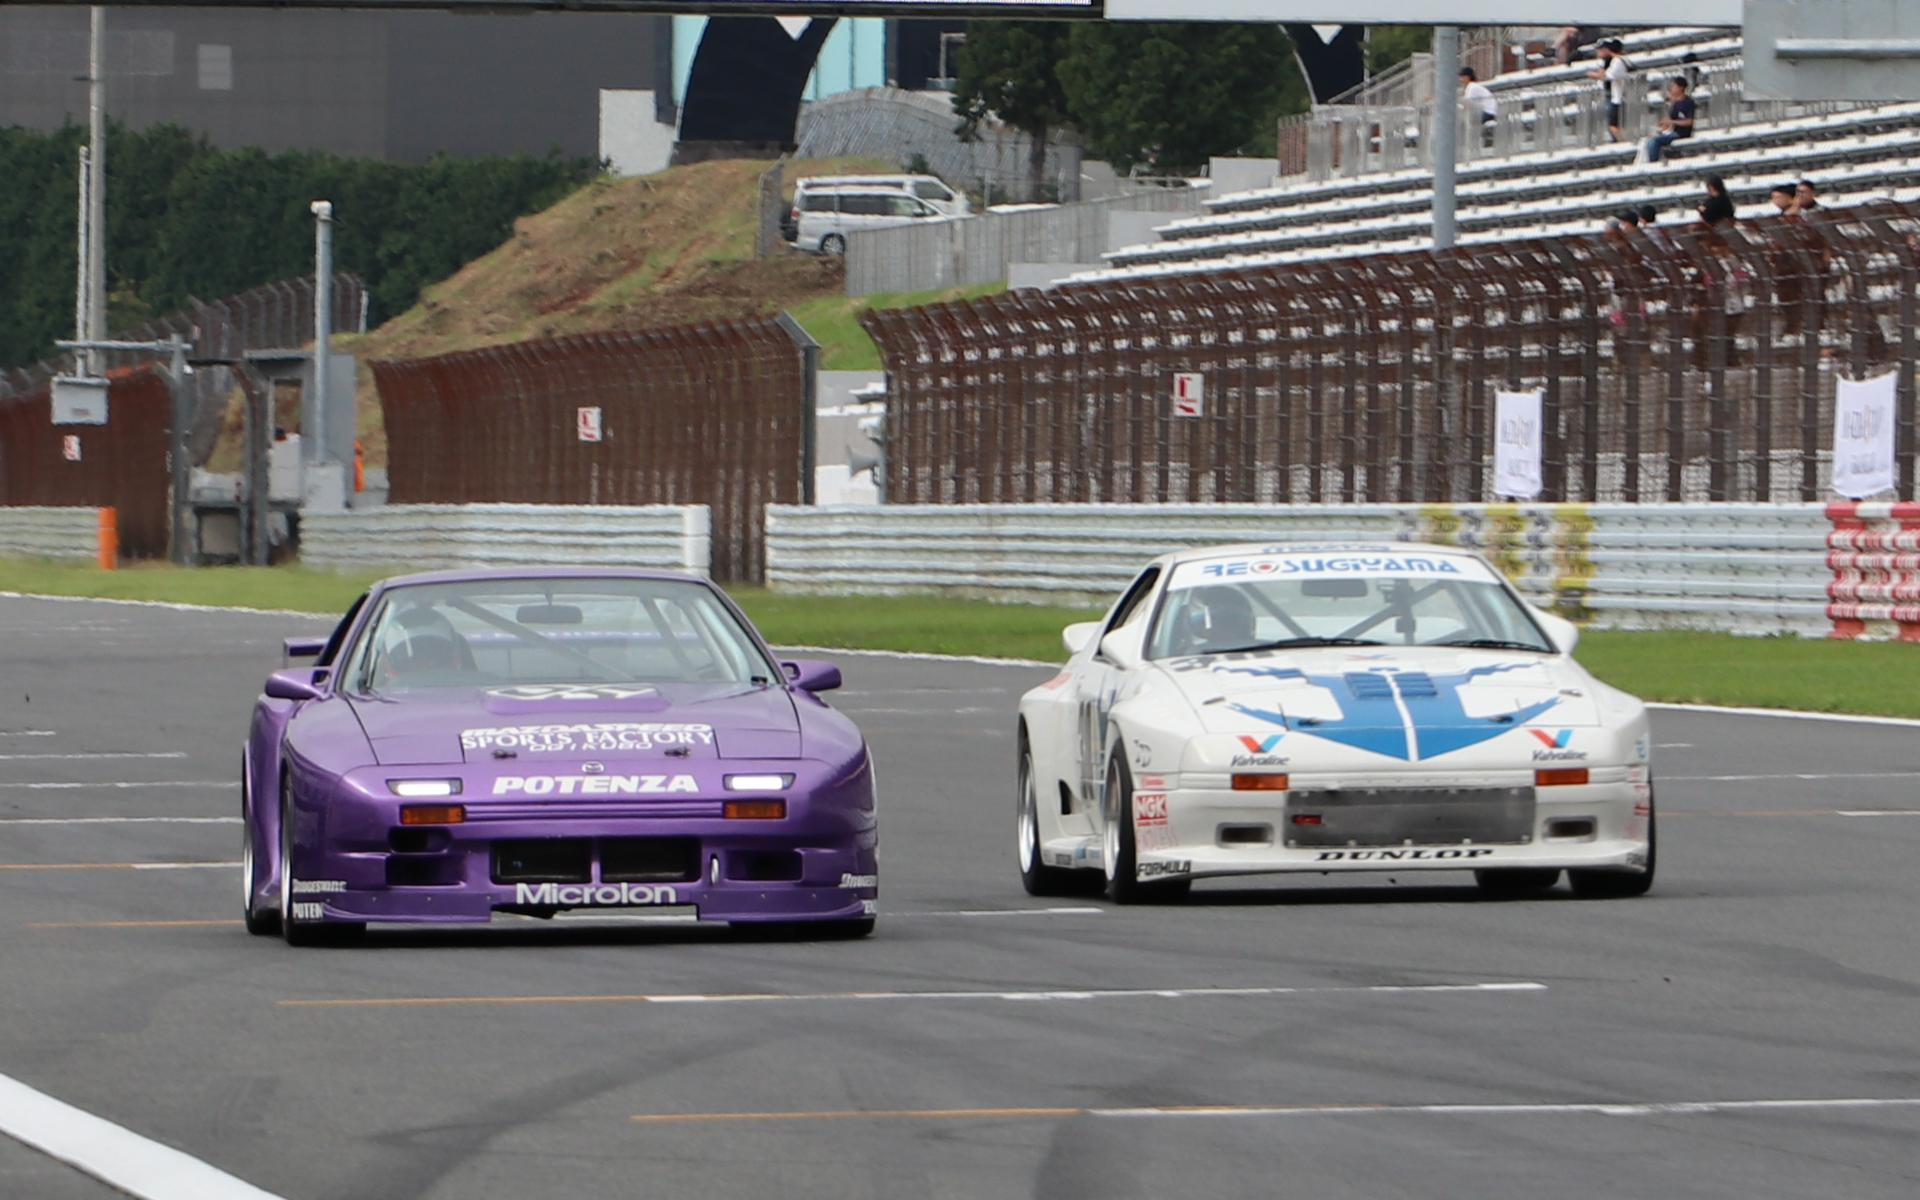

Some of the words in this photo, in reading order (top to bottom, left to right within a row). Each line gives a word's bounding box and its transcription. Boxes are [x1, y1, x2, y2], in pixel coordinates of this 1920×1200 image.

[1281, 557, 1461, 574] SUGIYAMA
[461, 723, 713, 737] MAZDASPEED
[461, 732, 573, 750] SPORTS
[586, 730, 717, 745] FACTORY
[1230, 754, 1291, 767] Valvoline
[1533, 749, 1588, 761] Valvoline
[492, 774, 699, 795] POTENZA
[1136, 795, 1168, 819] NGK
[1315, 849, 1493, 861] DUNLOP
[1137, 859, 1192, 877] FORMULA
[516, 882, 677, 904] Microlon
